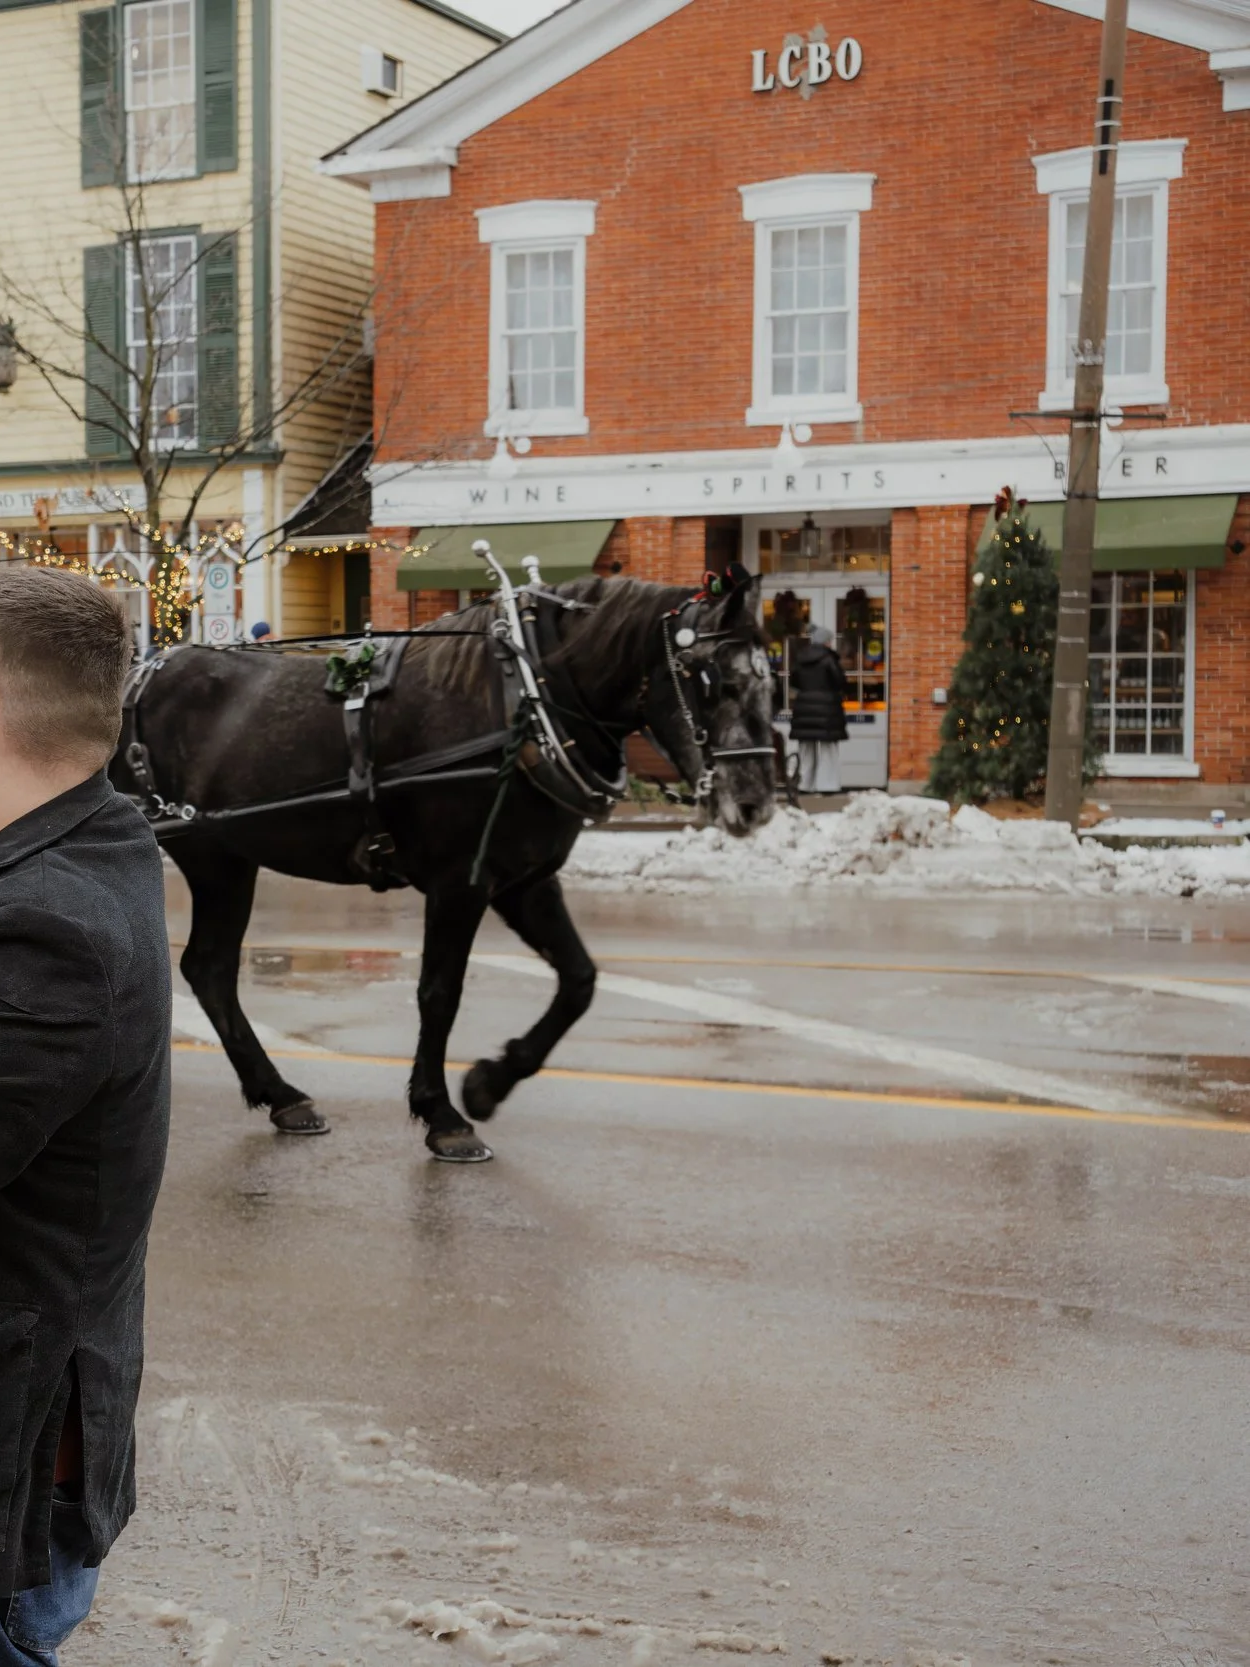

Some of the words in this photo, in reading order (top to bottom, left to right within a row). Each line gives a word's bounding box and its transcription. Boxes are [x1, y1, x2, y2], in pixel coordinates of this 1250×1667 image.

[750, 36, 863, 92] LCBO
[468, 485, 567, 505] WINE
[702, 470, 886, 497] SPIRITS
[1053, 456, 1168, 480] BER
